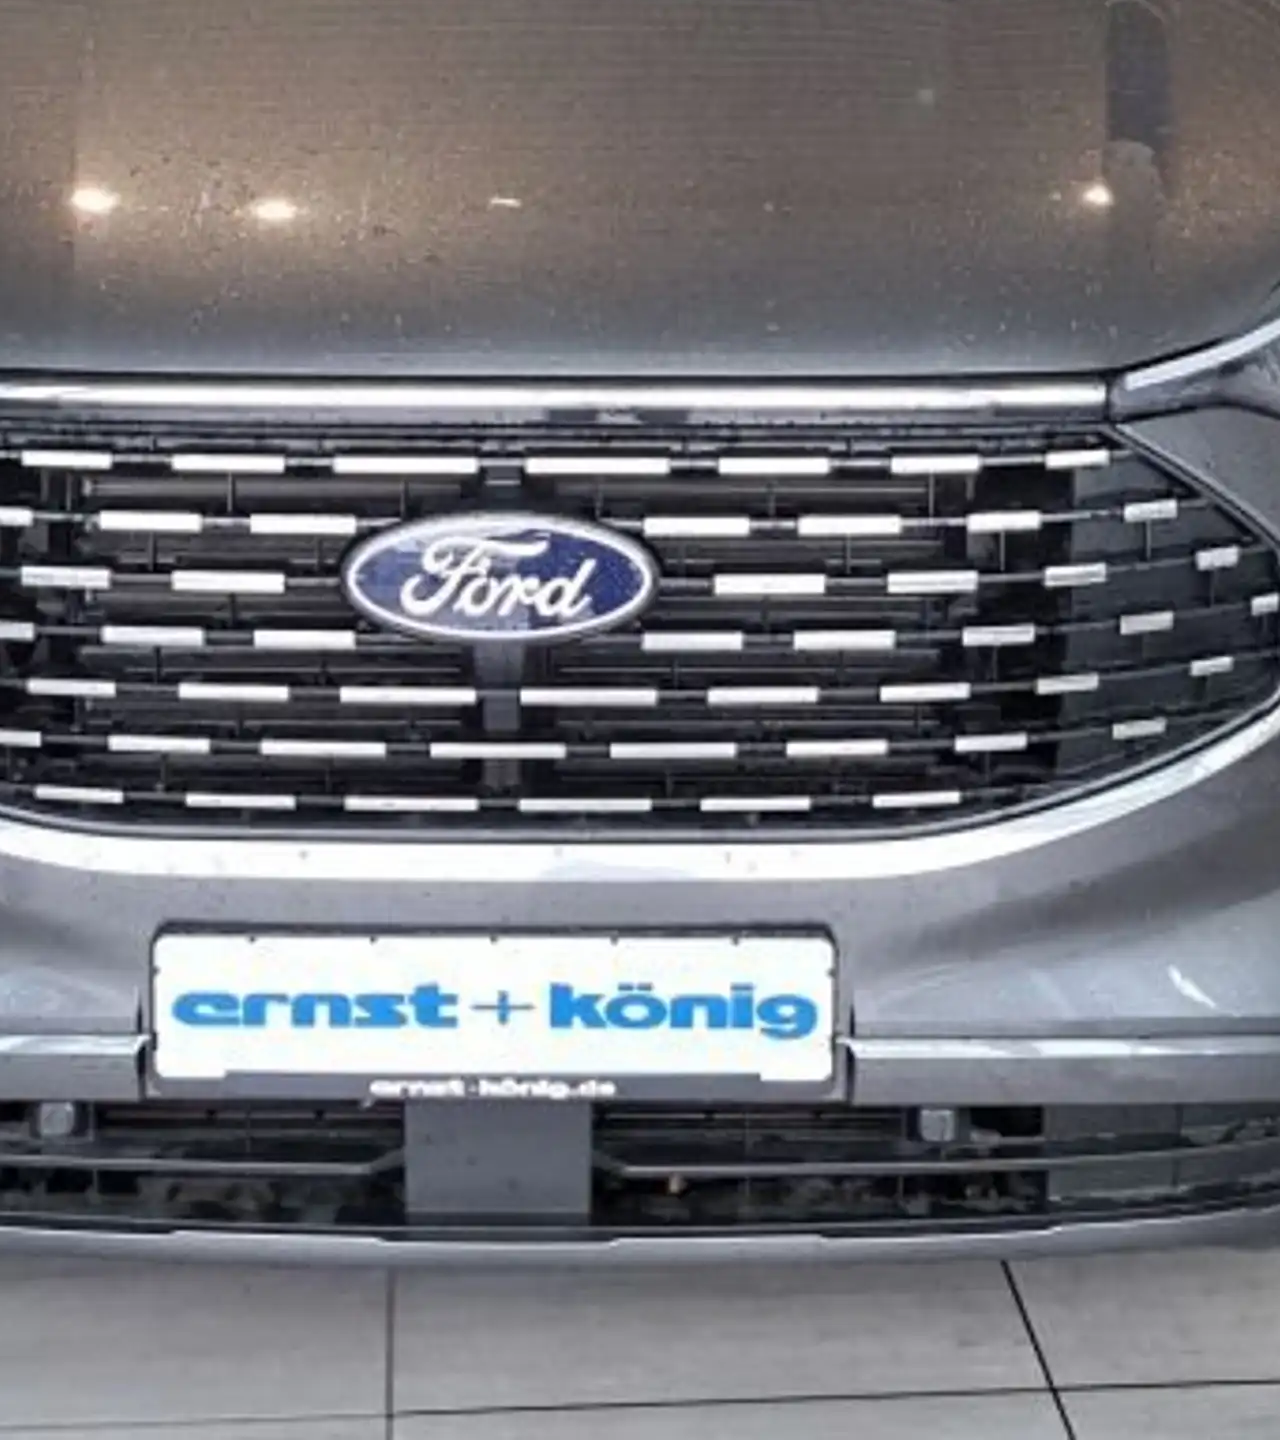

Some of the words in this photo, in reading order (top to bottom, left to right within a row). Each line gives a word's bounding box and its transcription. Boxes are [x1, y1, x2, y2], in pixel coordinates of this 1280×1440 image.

[400, 534, 597, 617] Ford
[172, 982, 459, 1028] ernst
[470, 990, 534, 1025] +
[549, 982, 818, 1039] könig
